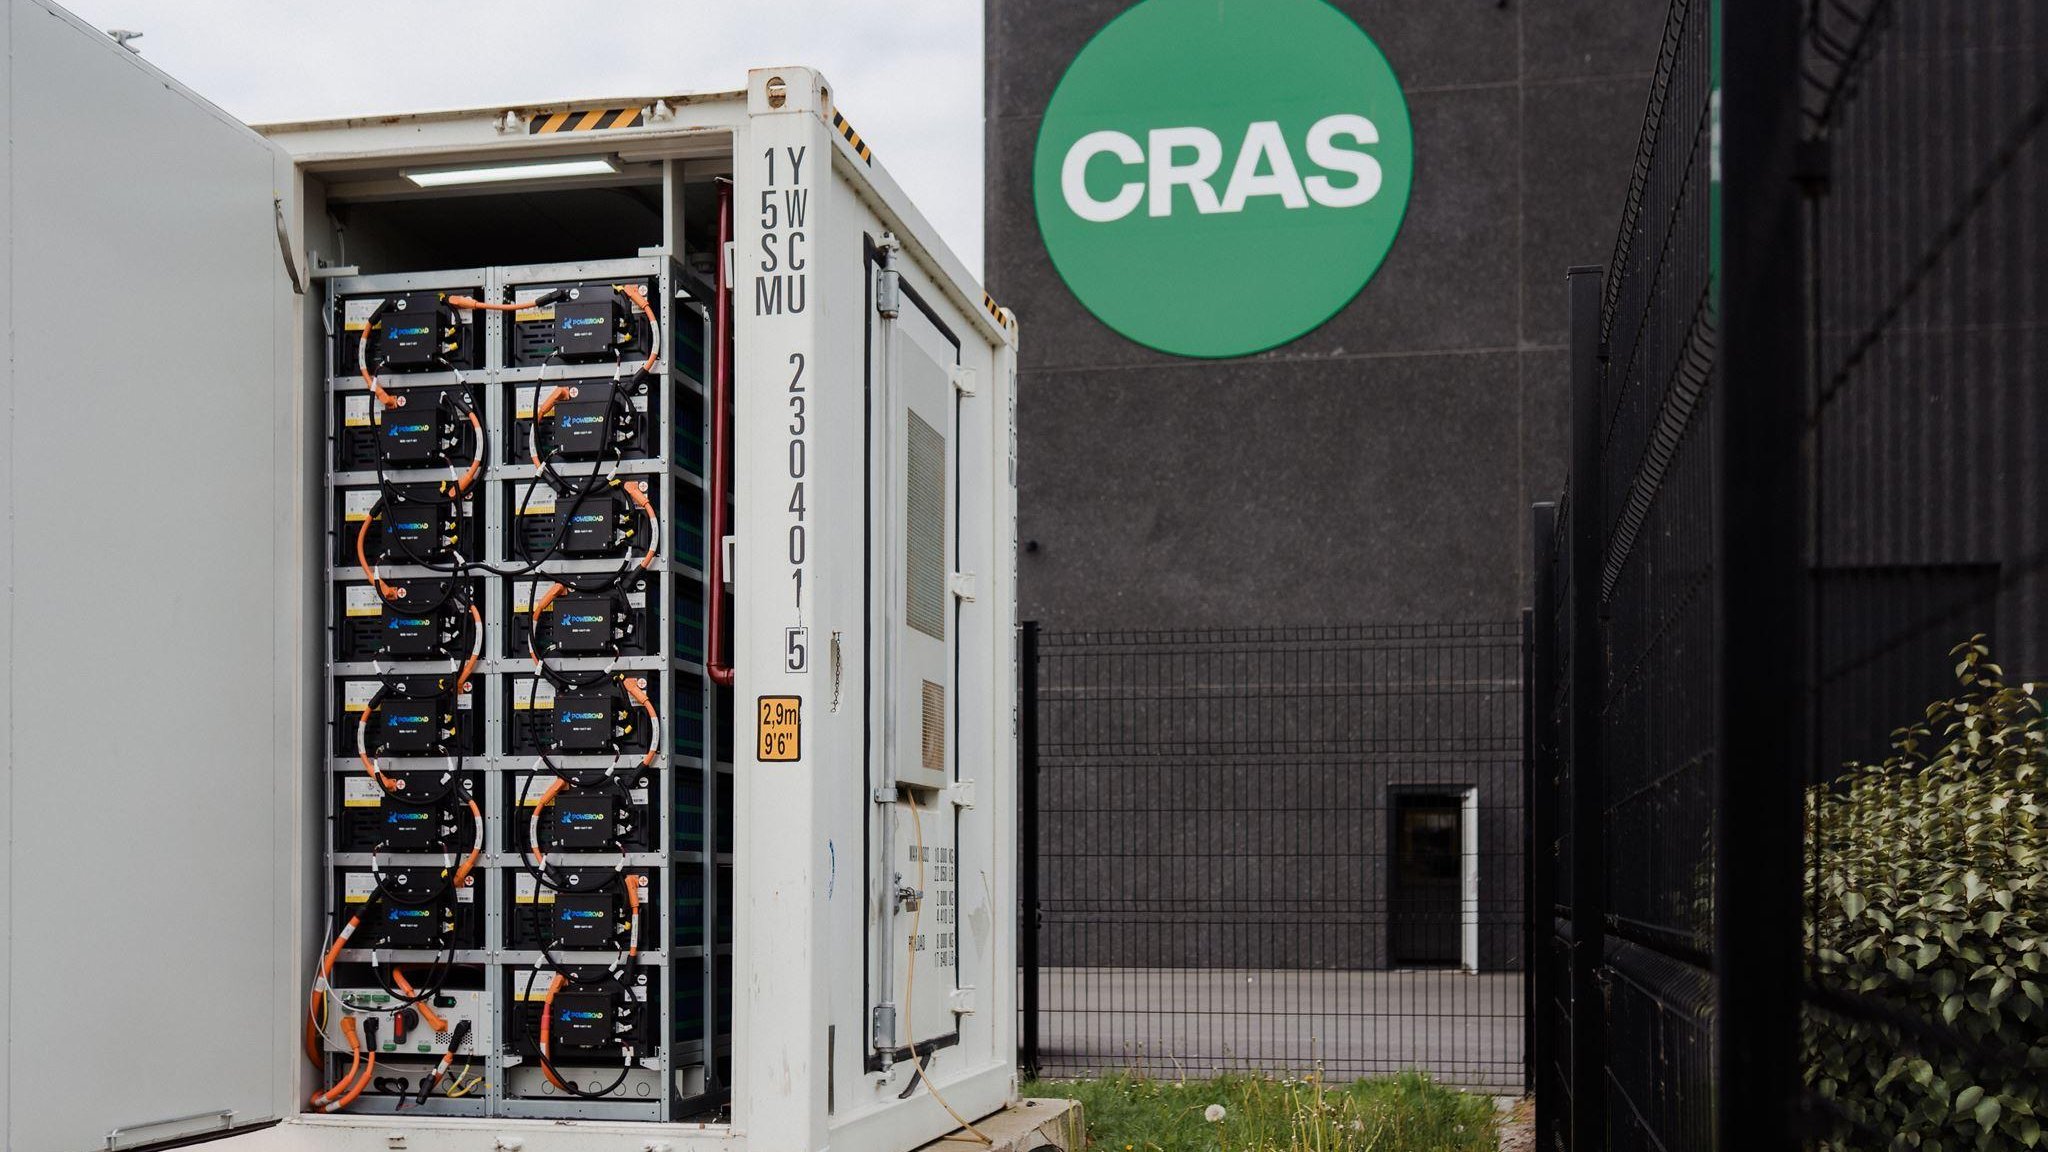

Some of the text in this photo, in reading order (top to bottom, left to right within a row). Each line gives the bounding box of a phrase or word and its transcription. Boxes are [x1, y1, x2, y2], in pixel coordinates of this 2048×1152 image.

[1061, 114, 1382, 222] CRAS
[788, 631, 806, 671] 5
[763, 703, 797, 729] 2,9m
[765, 732, 792, 755] 9'6"
